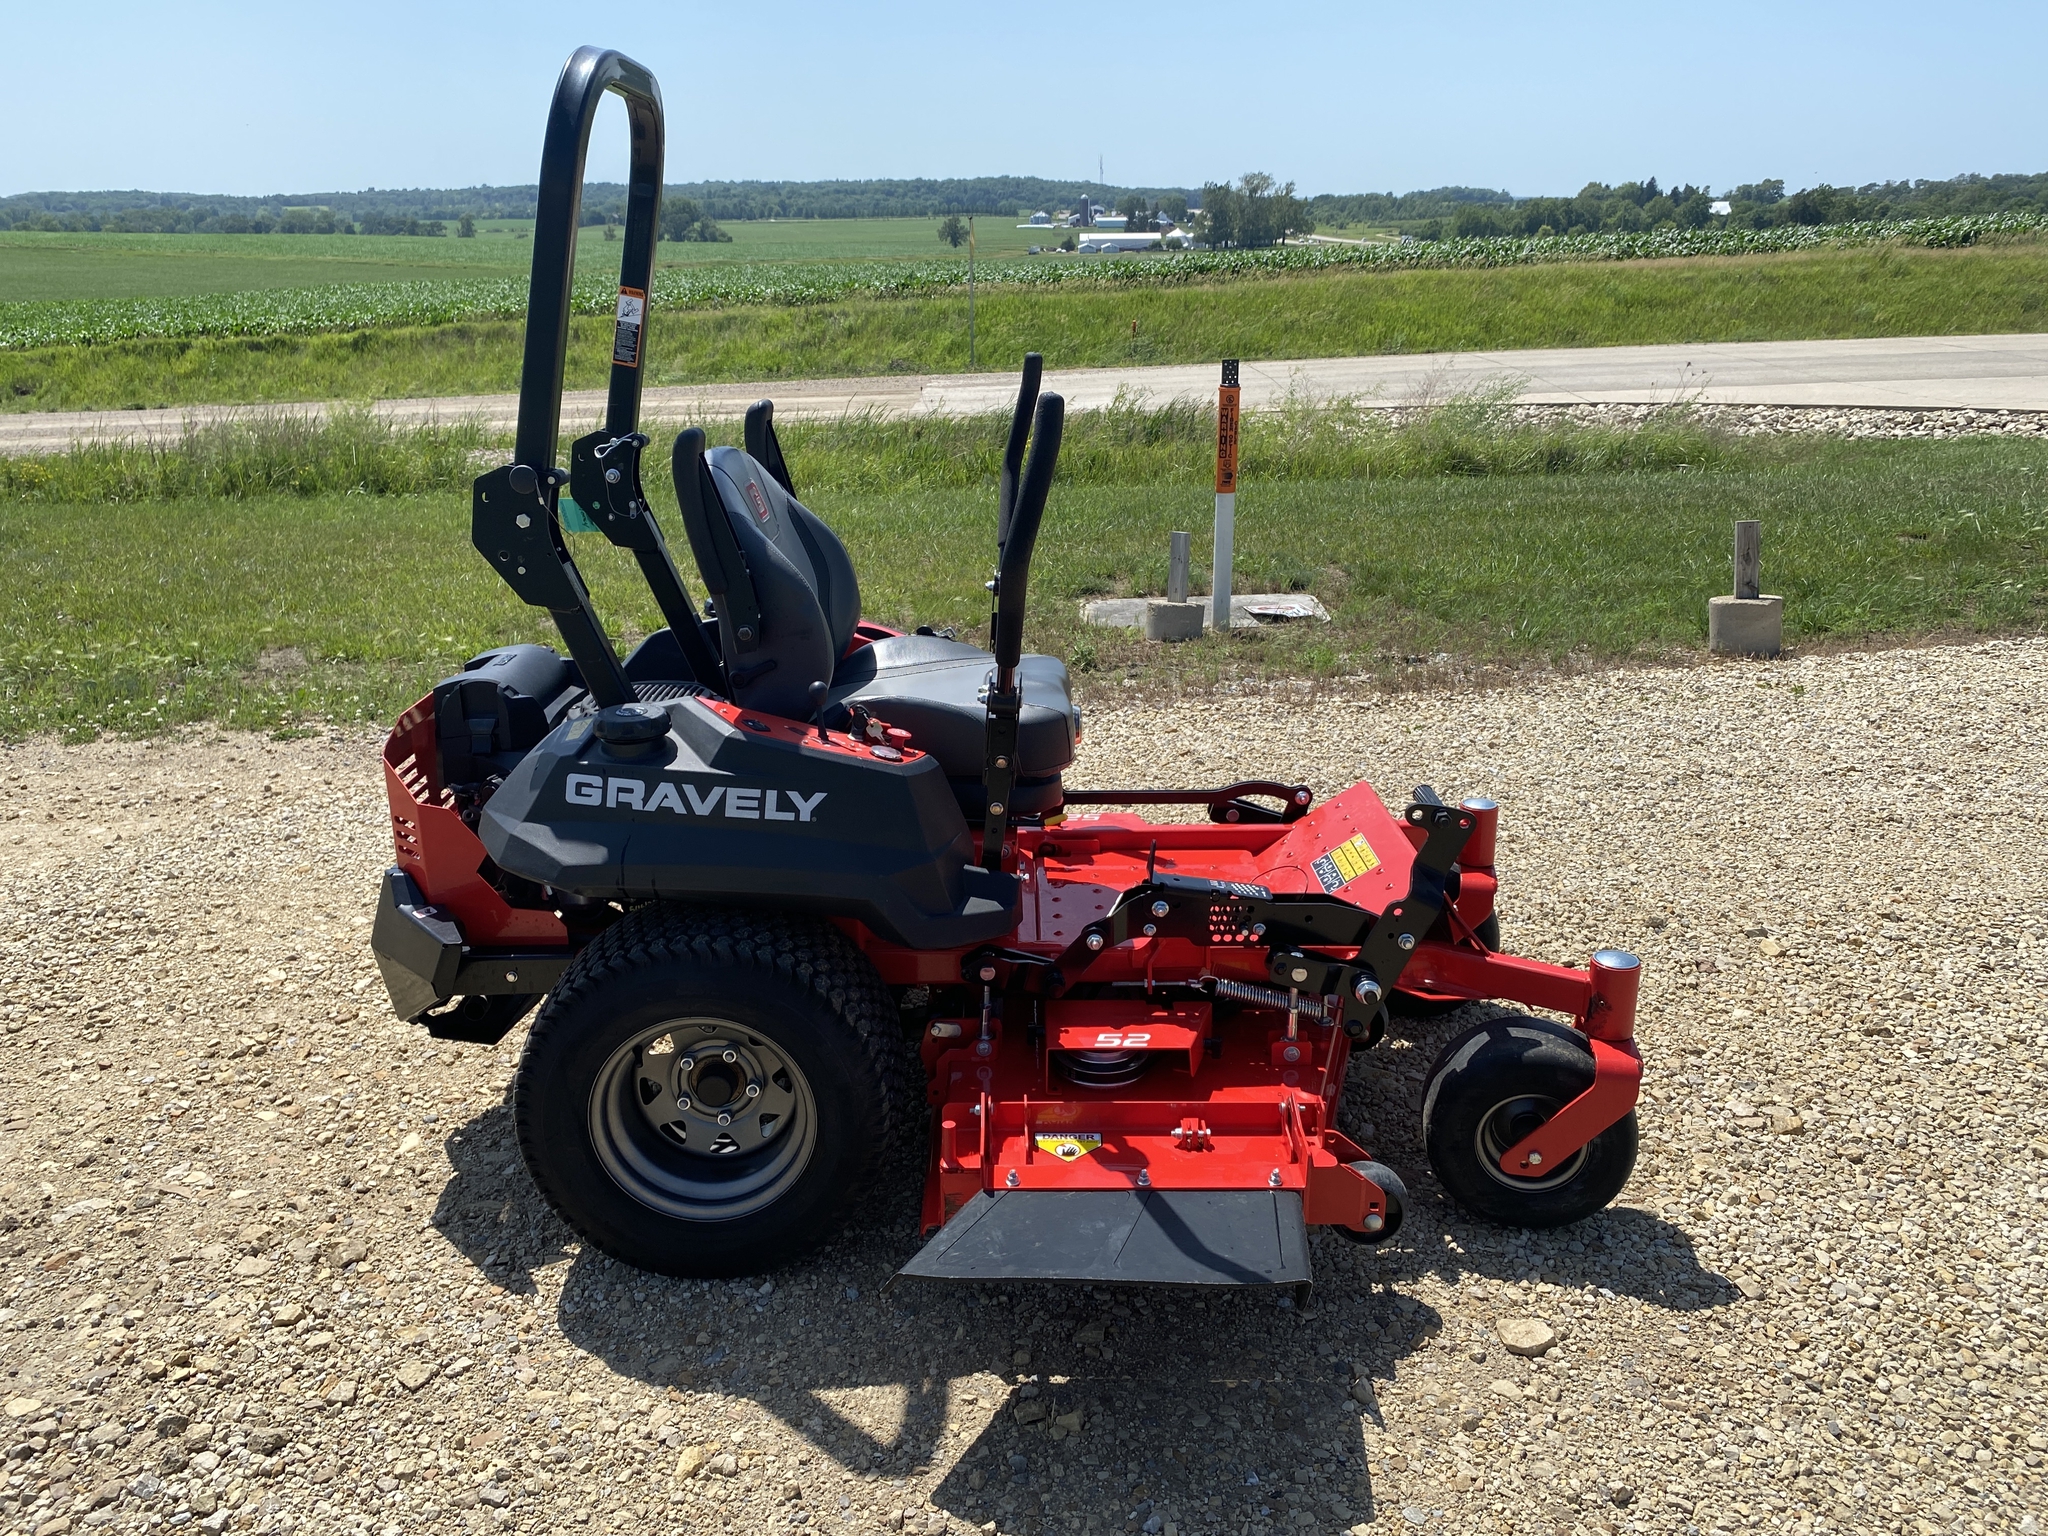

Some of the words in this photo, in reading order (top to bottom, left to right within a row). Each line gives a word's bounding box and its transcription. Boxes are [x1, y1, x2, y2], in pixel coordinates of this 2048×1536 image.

[1219, 408, 1228, 458] WARNING
[565, 773, 828, 822] GRAVELY
[1094, 1033, 1151, 1047] 52
